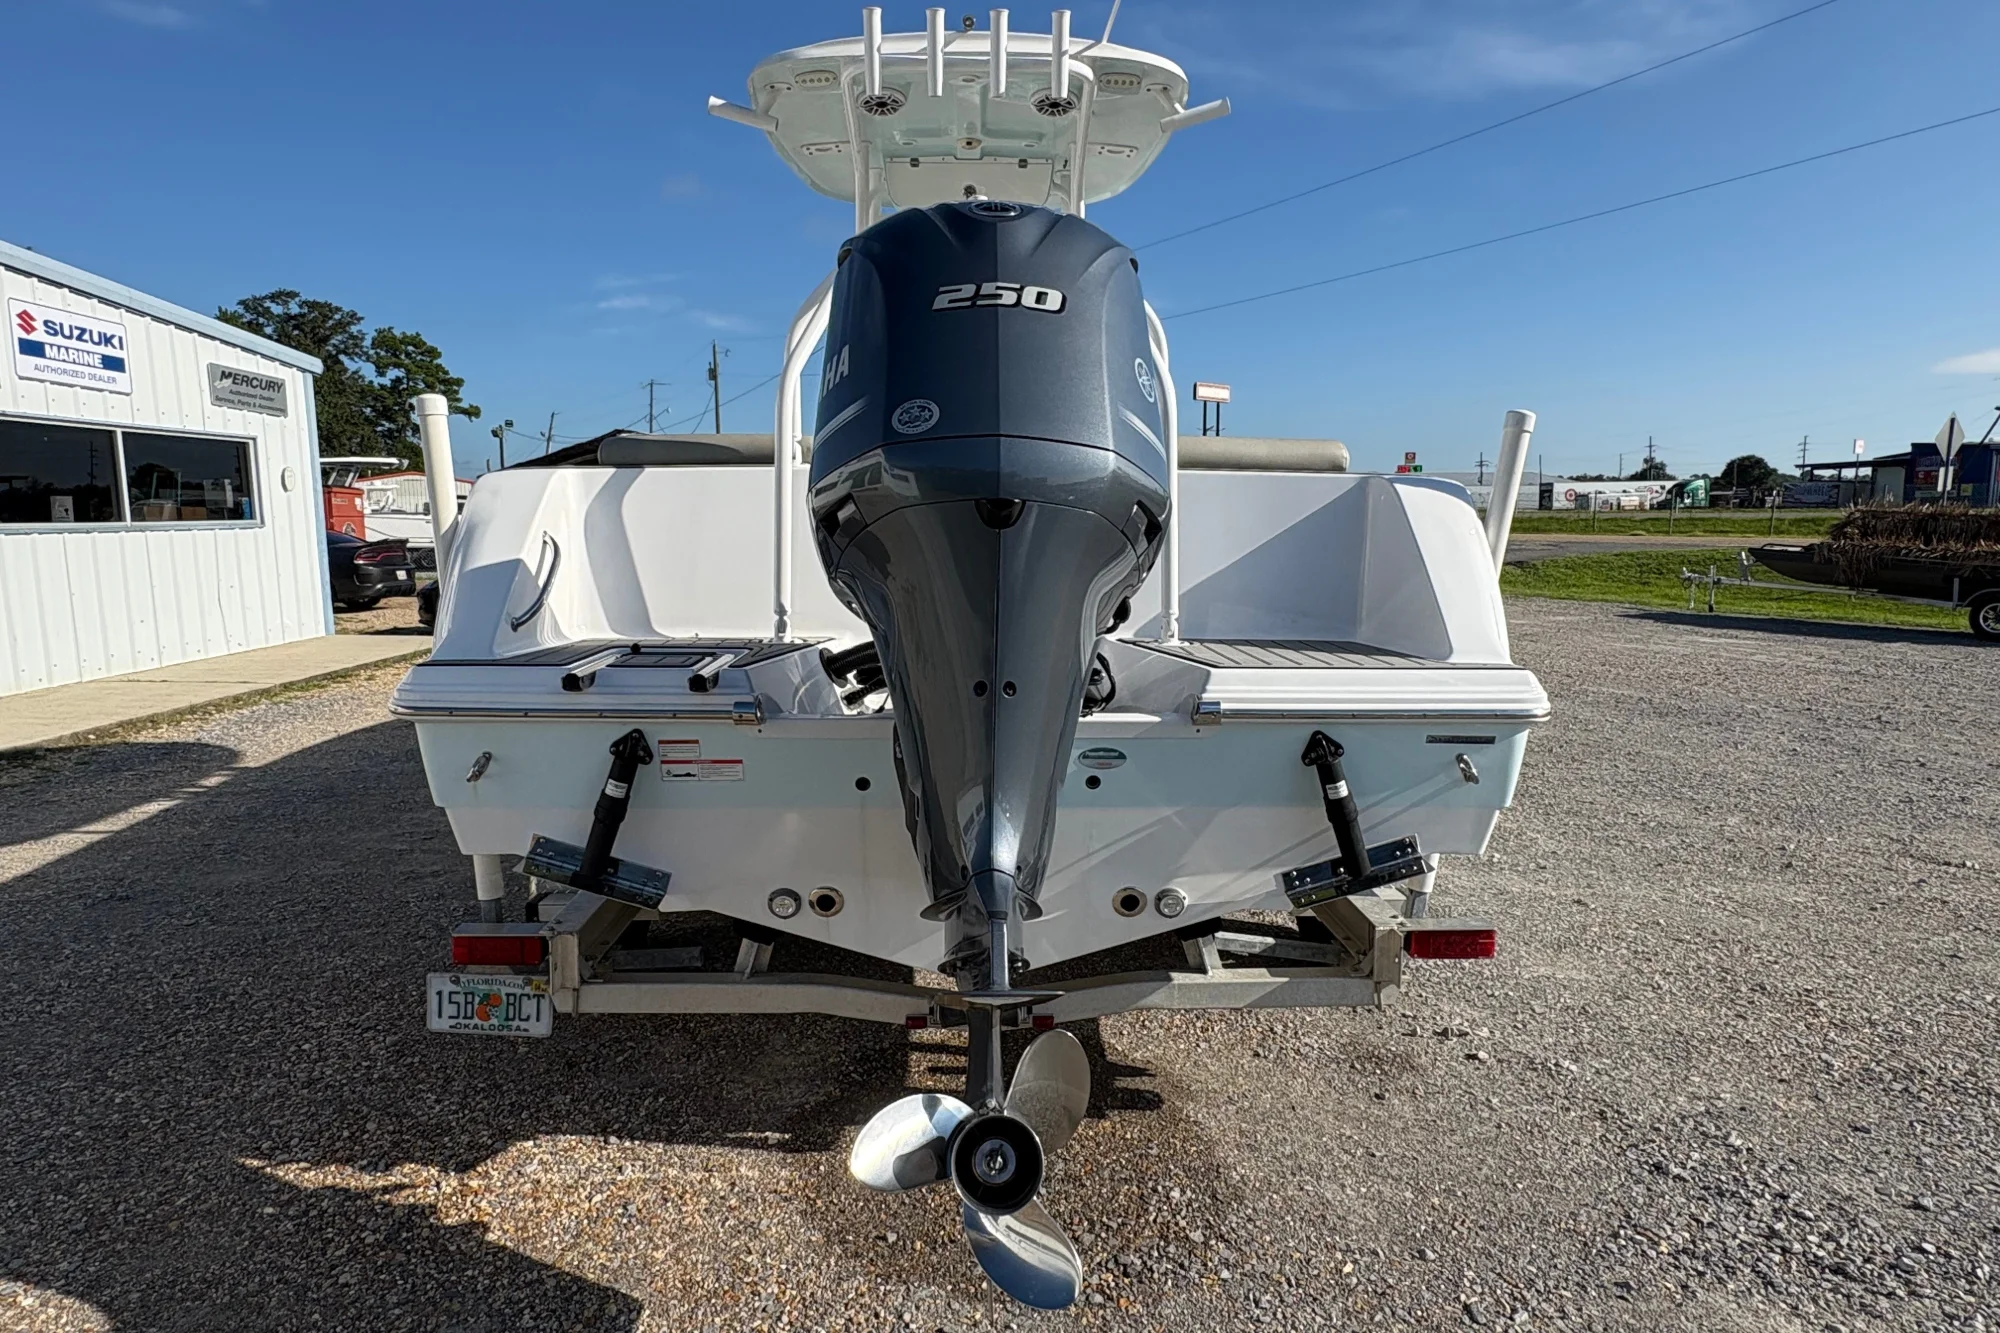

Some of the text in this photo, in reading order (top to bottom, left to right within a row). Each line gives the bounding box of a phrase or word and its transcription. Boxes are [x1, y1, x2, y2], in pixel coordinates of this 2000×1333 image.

[931, 282, 1066, 313] 250
[43, 319, 124, 351] SUZUKI
[44, 343, 104, 368] MARINE
[33, 363, 117, 384] AUTHORIZED DEALER
[219, 370, 283, 394] MERCURY
[505, 993, 545, 1022] BCT
[454, 1022, 522, 1032] OKALOOSA
